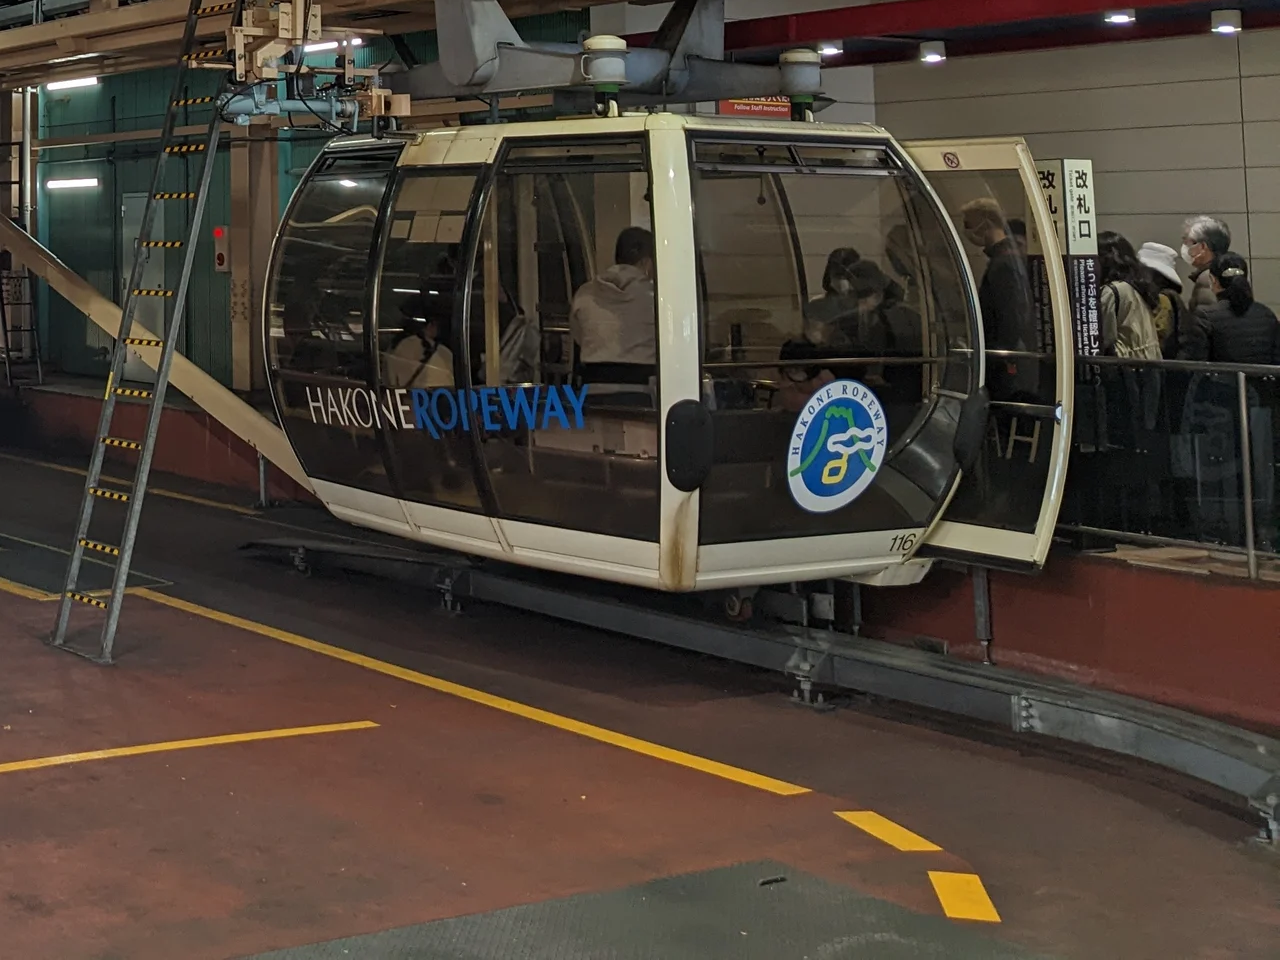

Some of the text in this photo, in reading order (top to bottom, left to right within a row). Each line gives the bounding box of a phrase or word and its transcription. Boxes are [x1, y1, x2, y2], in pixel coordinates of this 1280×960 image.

[1074, 169, 1092, 239] 改札口
[1082, 323, 1090, 345] ticket
[305, 384, 590, 440] HAKONE ROPEWAY
[792, 384, 885, 455] HAKONE ROPEWAY
[889, 533, 917, 552] 116
